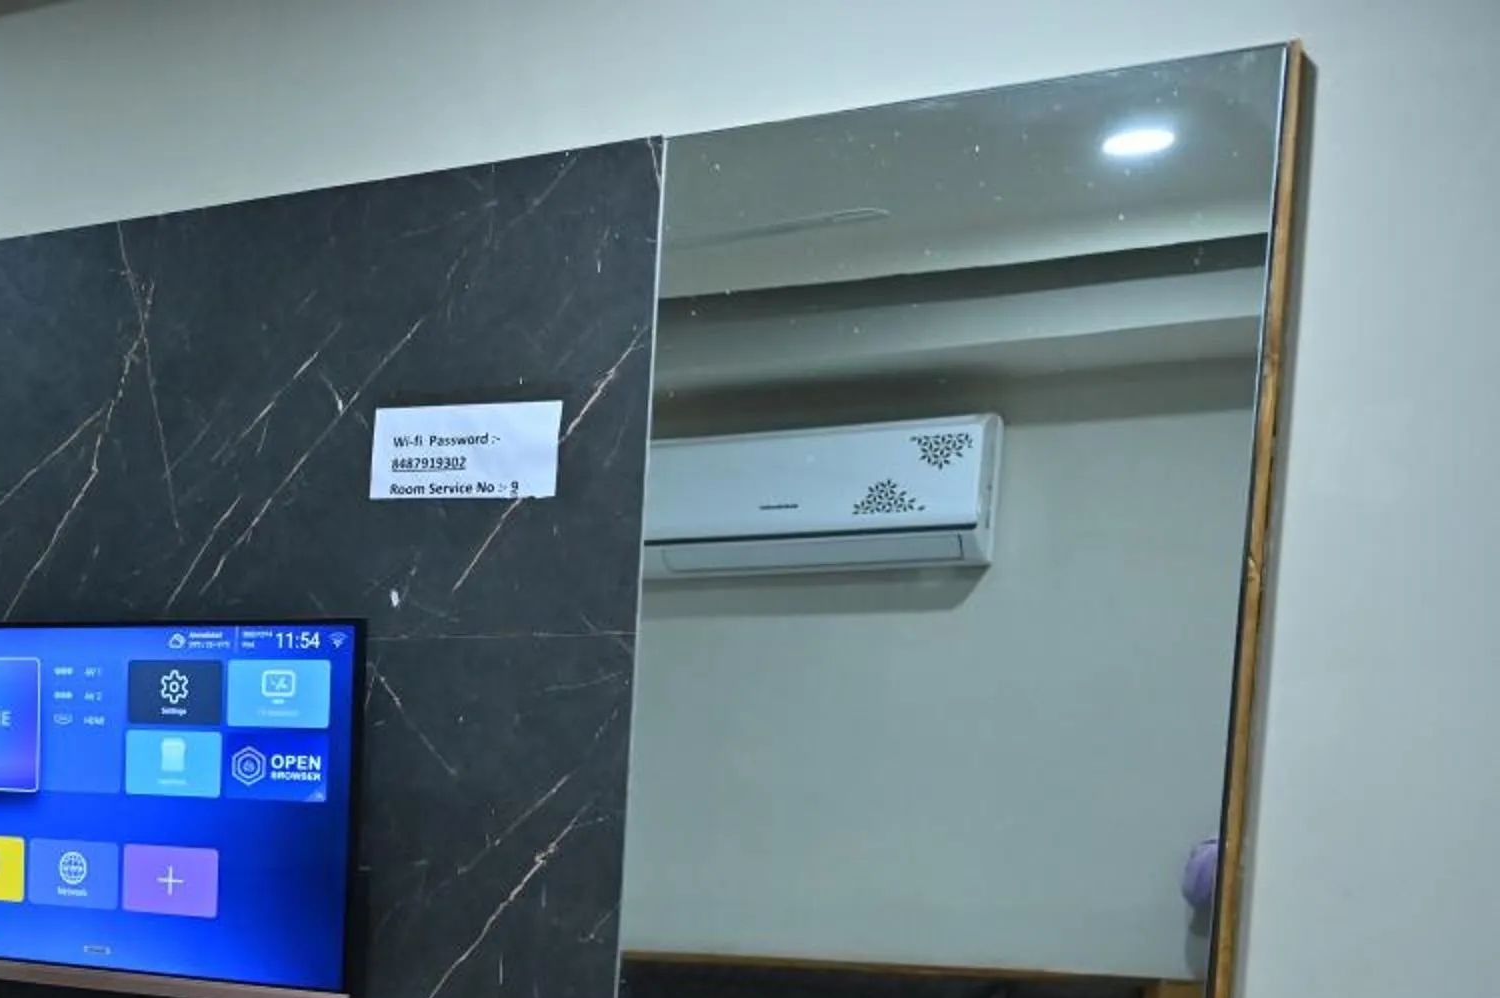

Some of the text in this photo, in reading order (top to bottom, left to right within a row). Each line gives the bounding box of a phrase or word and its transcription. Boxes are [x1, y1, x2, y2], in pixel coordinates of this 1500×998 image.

[393, 435, 423, 448] Wi-fi
[429, 432, 489, 447] Password
[389, 483, 425, 495] Room
[429, 482, 473, 494] Service
[476, 481, 495, 493] No
[275, 631, 320, 649] 11:54
[270, 754, 322, 770] OPEN
[270, 771, 321, 782] BROWSER
